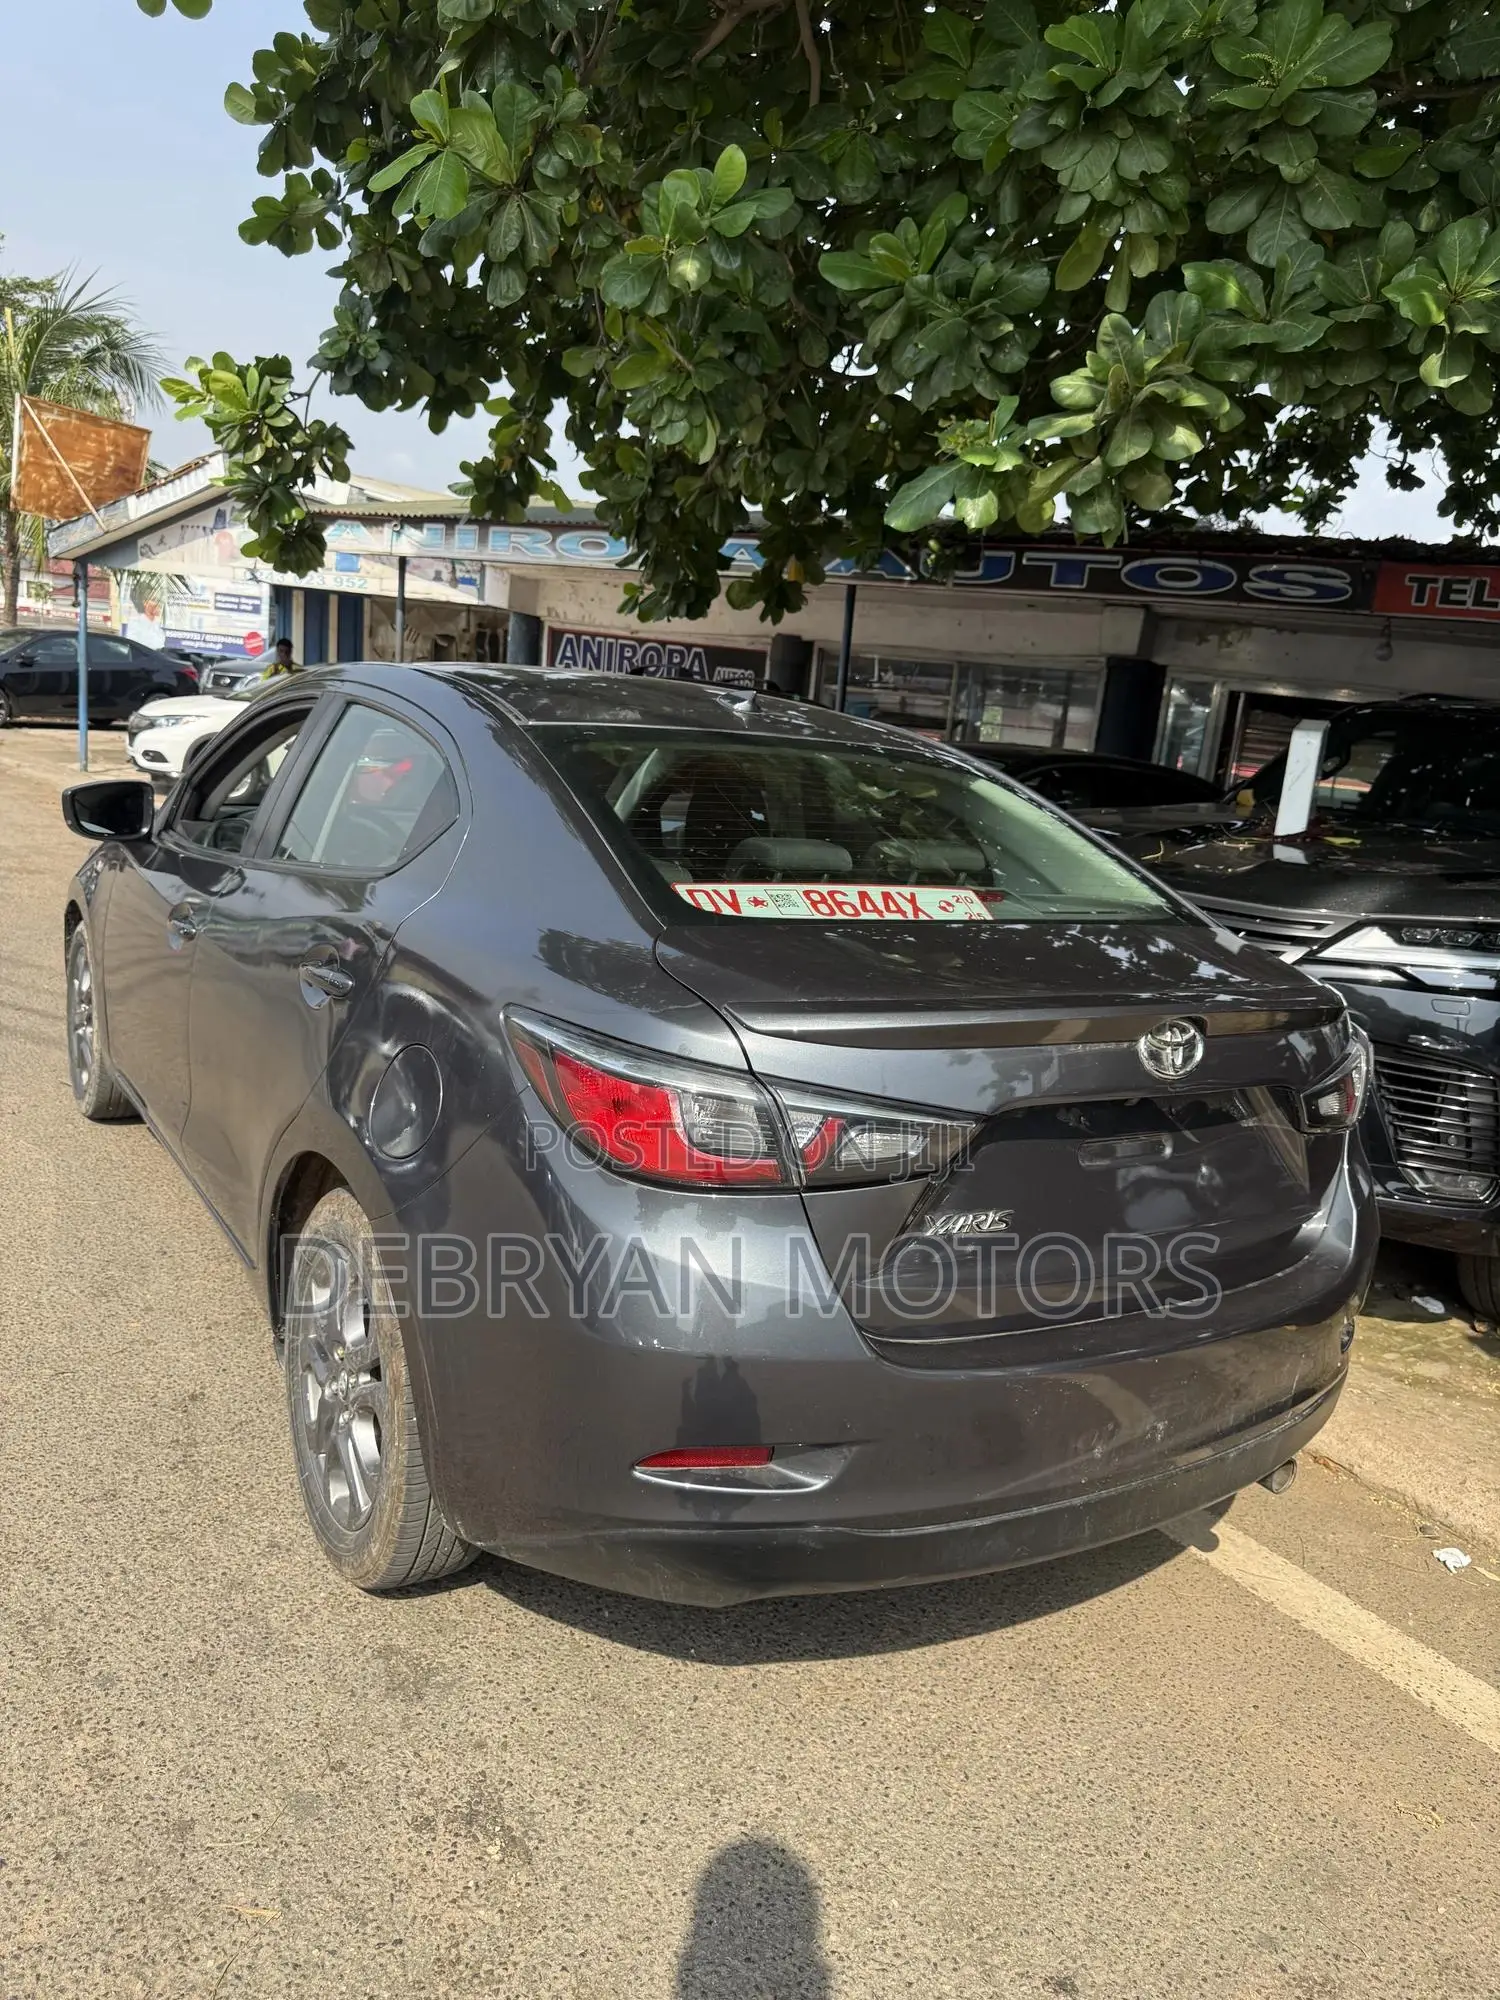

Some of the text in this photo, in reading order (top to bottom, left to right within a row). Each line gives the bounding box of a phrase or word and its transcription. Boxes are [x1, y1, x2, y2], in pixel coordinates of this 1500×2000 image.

[333, 576, 369, 590] 952
[824, 544, 1353, 604] AUTOS
[1405, 573, 1500, 612] TEL
[555, 633, 709, 682] ANIROPA
[802, 889, 934, 919] 8644X
[925, 1210, 1015, 1236] YARIS
